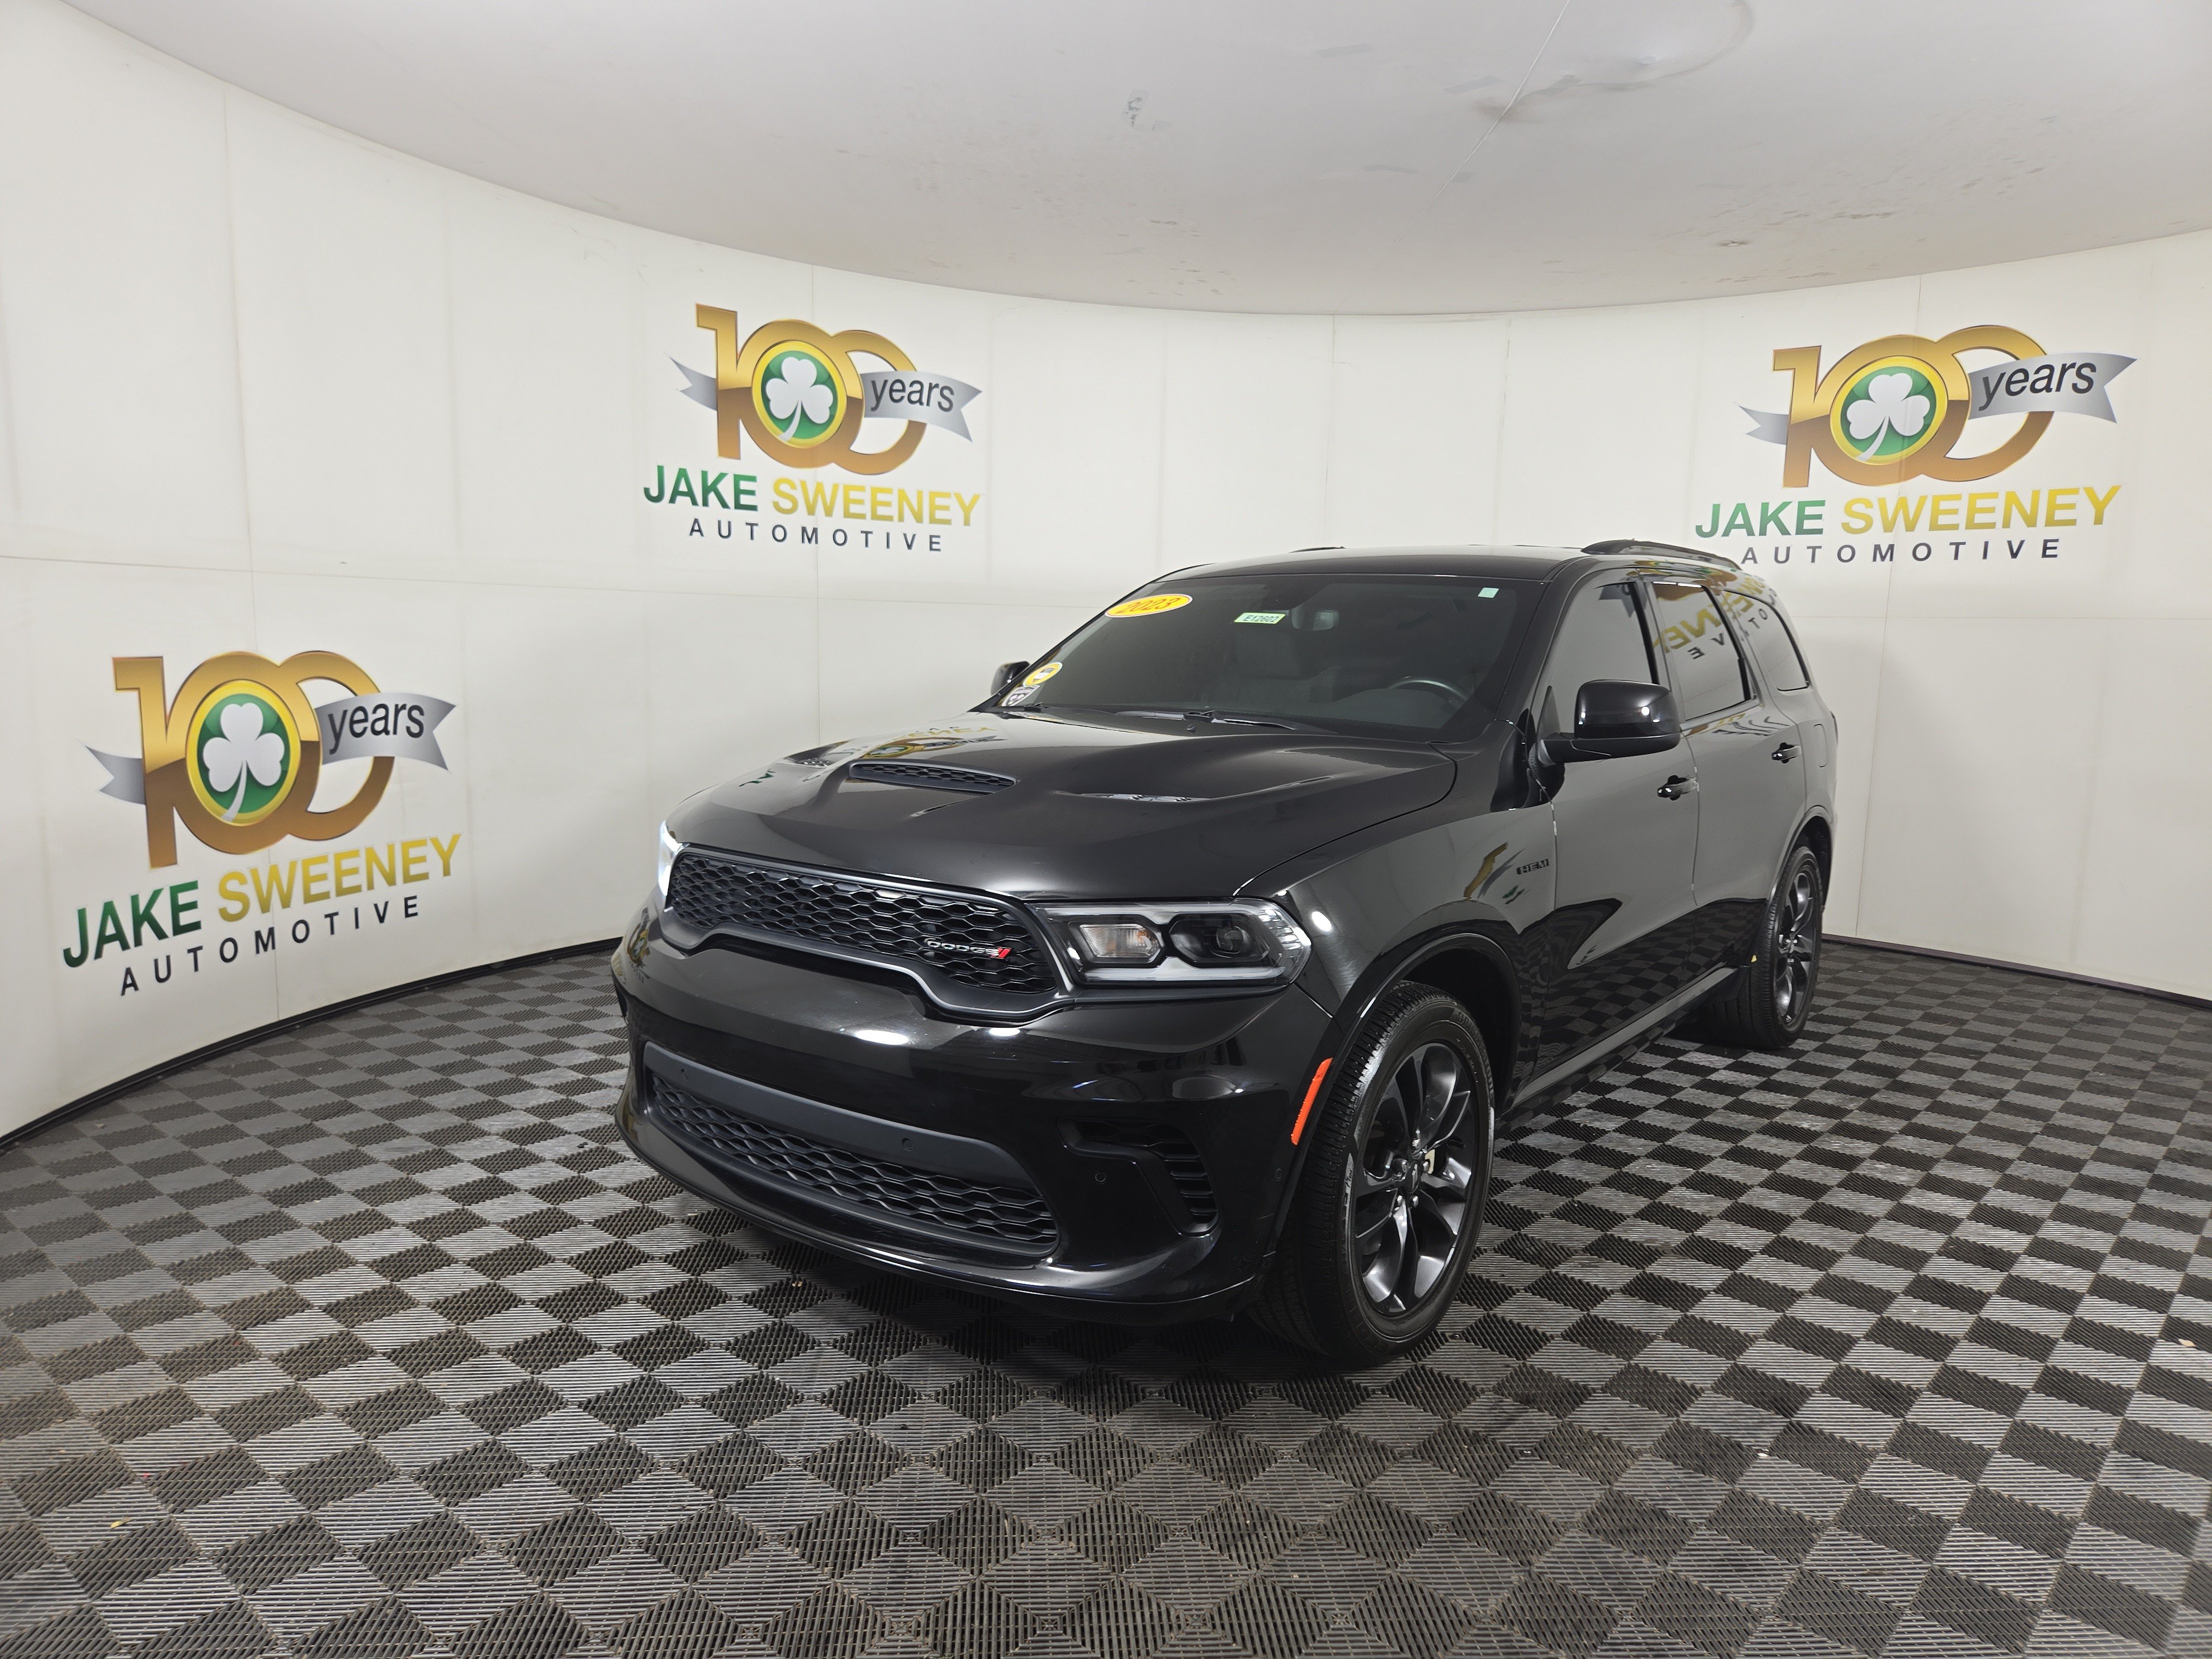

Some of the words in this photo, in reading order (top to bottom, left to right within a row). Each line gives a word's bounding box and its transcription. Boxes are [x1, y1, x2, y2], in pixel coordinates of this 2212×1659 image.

[870, 378, 955, 412] years
[1978, 361, 2097, 411] years
[643, 465, 758, 512] JAKE
[772, 477, 981, 526] SWEENEY
[1695, 499, 1826, 538] JAKE
[1841, 485, 2122, 535] SWEENEY
[689, 518, 942, 552] AUTOMOTIVE
[1741, 538, 2060, 565] AUTOMOTIVE
[1115, 597, 1181, 614] 2023
[327, 703, 425, 755] years
[62, 880, 202, 968] JAKE
[217, 833, 462, 922] SWEENEY
[120, 896, 419, 996] AUTOMOTIVE
[926, 941, 999, 956] DODGE
